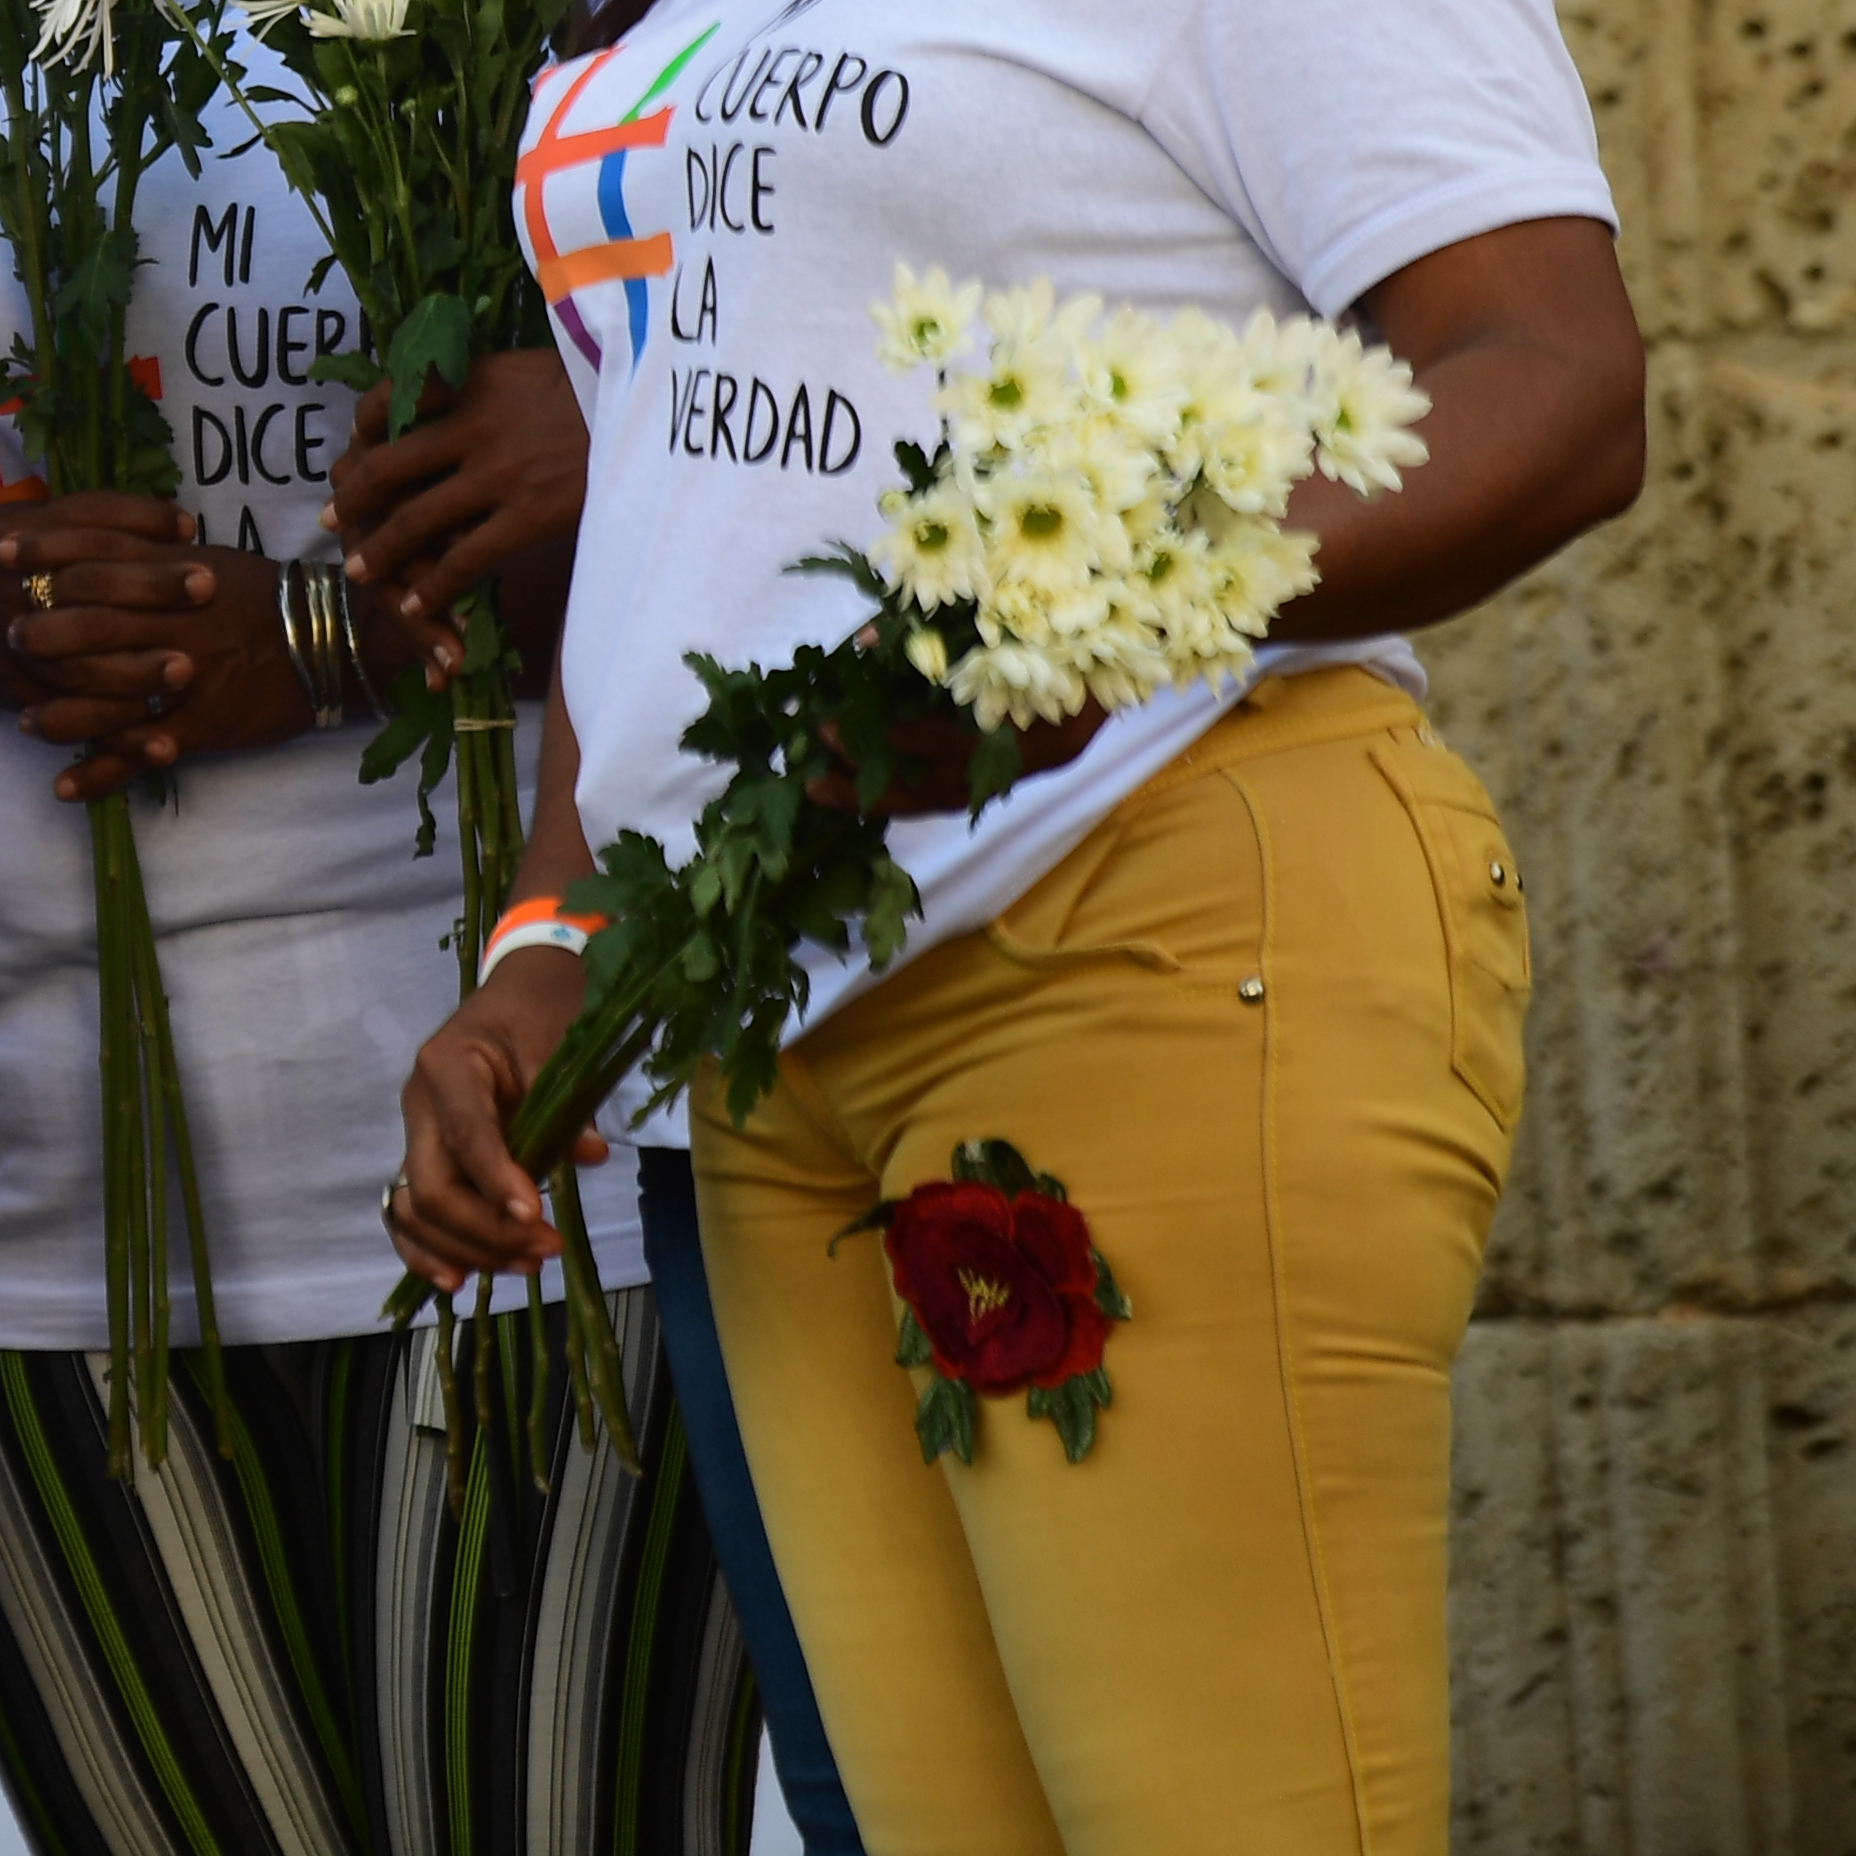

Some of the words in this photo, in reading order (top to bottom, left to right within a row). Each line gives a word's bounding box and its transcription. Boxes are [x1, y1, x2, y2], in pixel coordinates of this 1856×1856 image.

[694, 48, 911, 149] CUERPO
[687, 142, 777, 234] DICE
[189, 202, 256, 288] MI
[184, 301, 375, 389] CUER
[671, 253, 718, 347] LA
[192, 402, 328, 487] DICE
[669, 366, 863, 478] VERDAD
